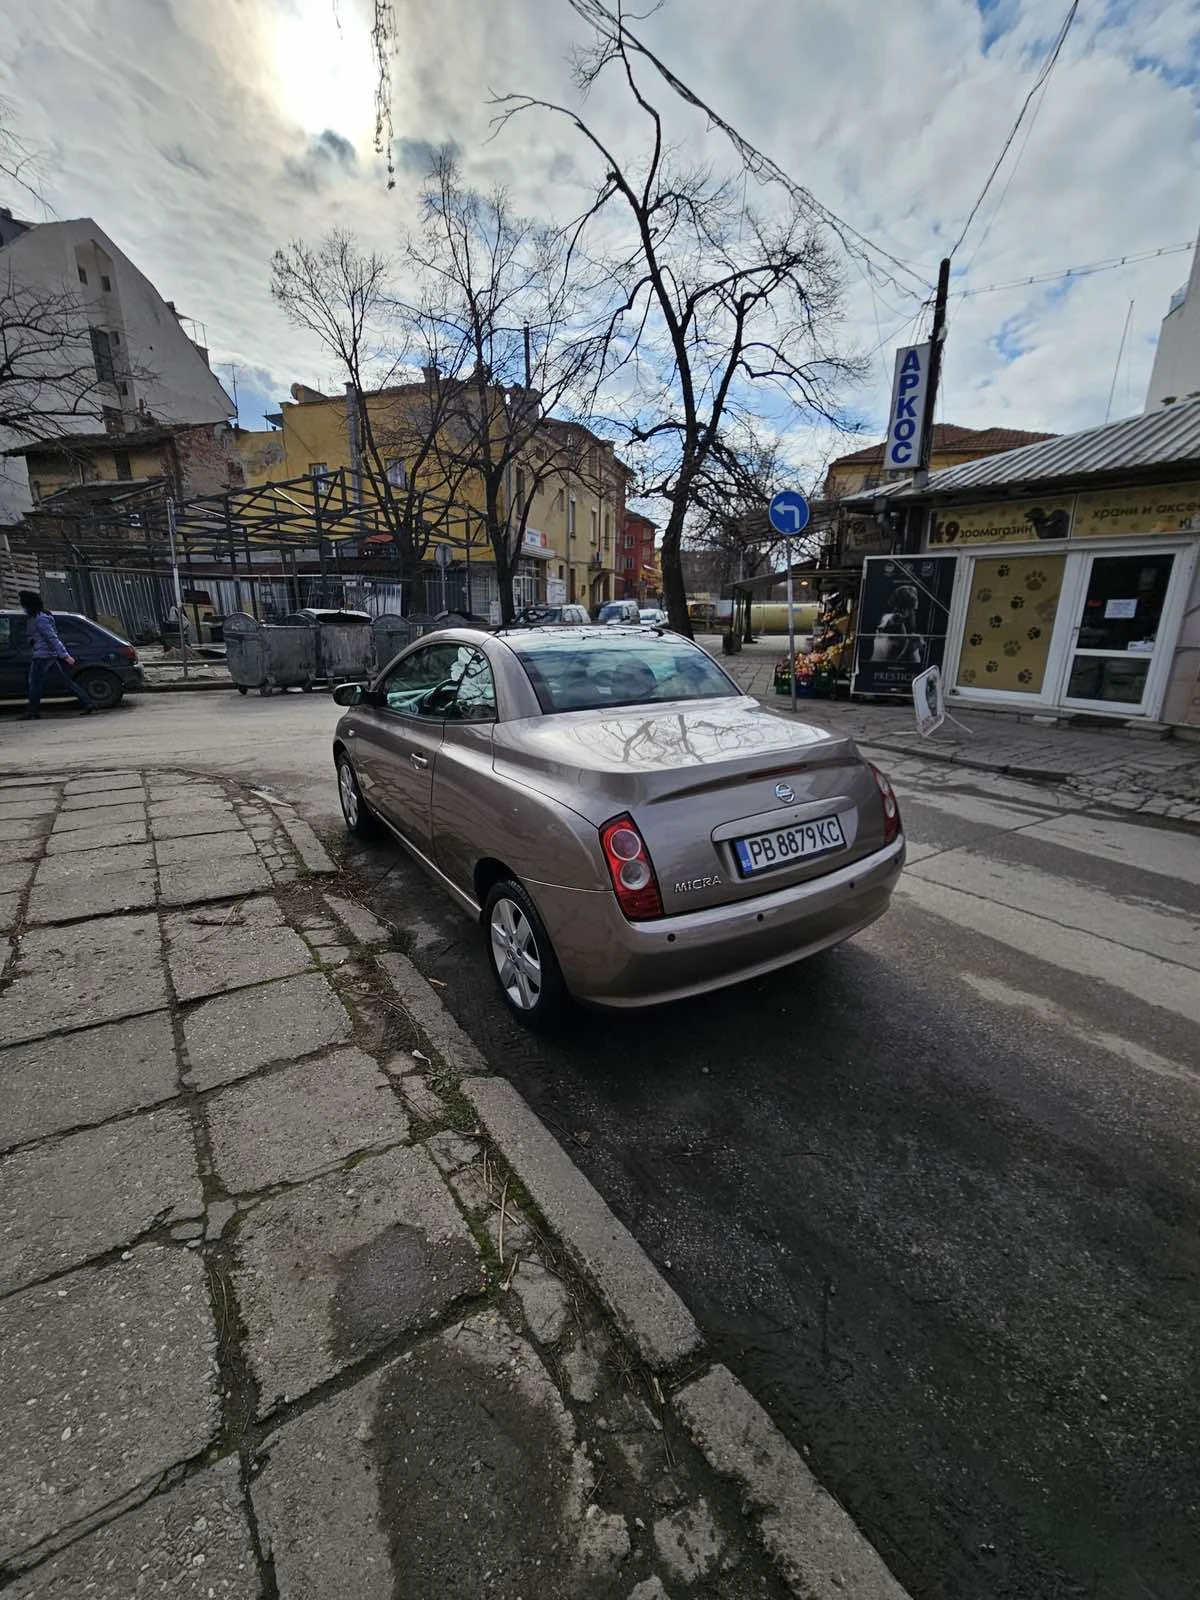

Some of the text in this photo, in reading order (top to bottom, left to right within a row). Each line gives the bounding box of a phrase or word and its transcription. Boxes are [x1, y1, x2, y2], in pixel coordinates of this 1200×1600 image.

[891, 349, 920, 464] АРКОС
[1092, 502, 1200, 520] храни и аксе
[959, 525, 1033, 539] зоомагазин
[749, 821, 840, 865] PB 8879 KC
[674, 875, 721, 894] MICRA
